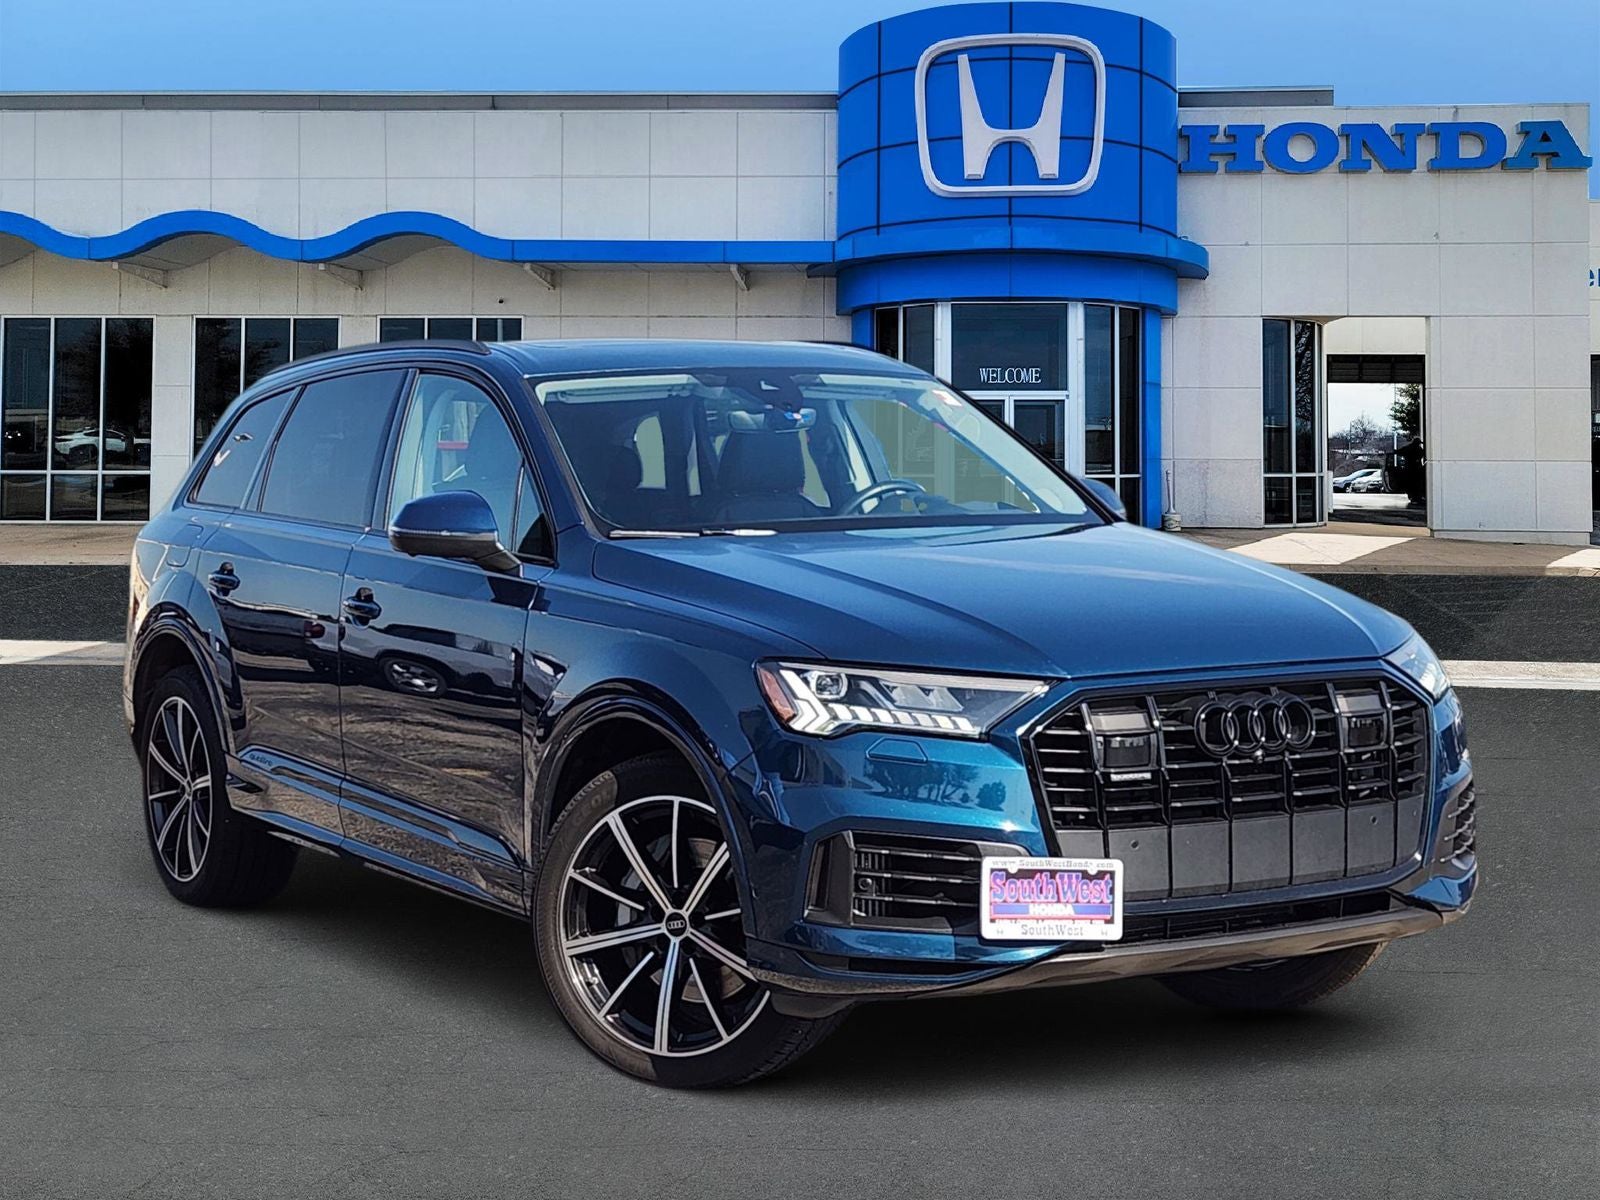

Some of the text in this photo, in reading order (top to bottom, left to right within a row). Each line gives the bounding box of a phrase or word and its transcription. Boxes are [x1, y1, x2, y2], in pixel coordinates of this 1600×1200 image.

[1179, 121, 1592, 173] HONDA
[980, 367, 1041, 384] WELCOME
[991, 871, 1113, 903] SouthWest
[1021, 924, 1083, 936] SouthWest
